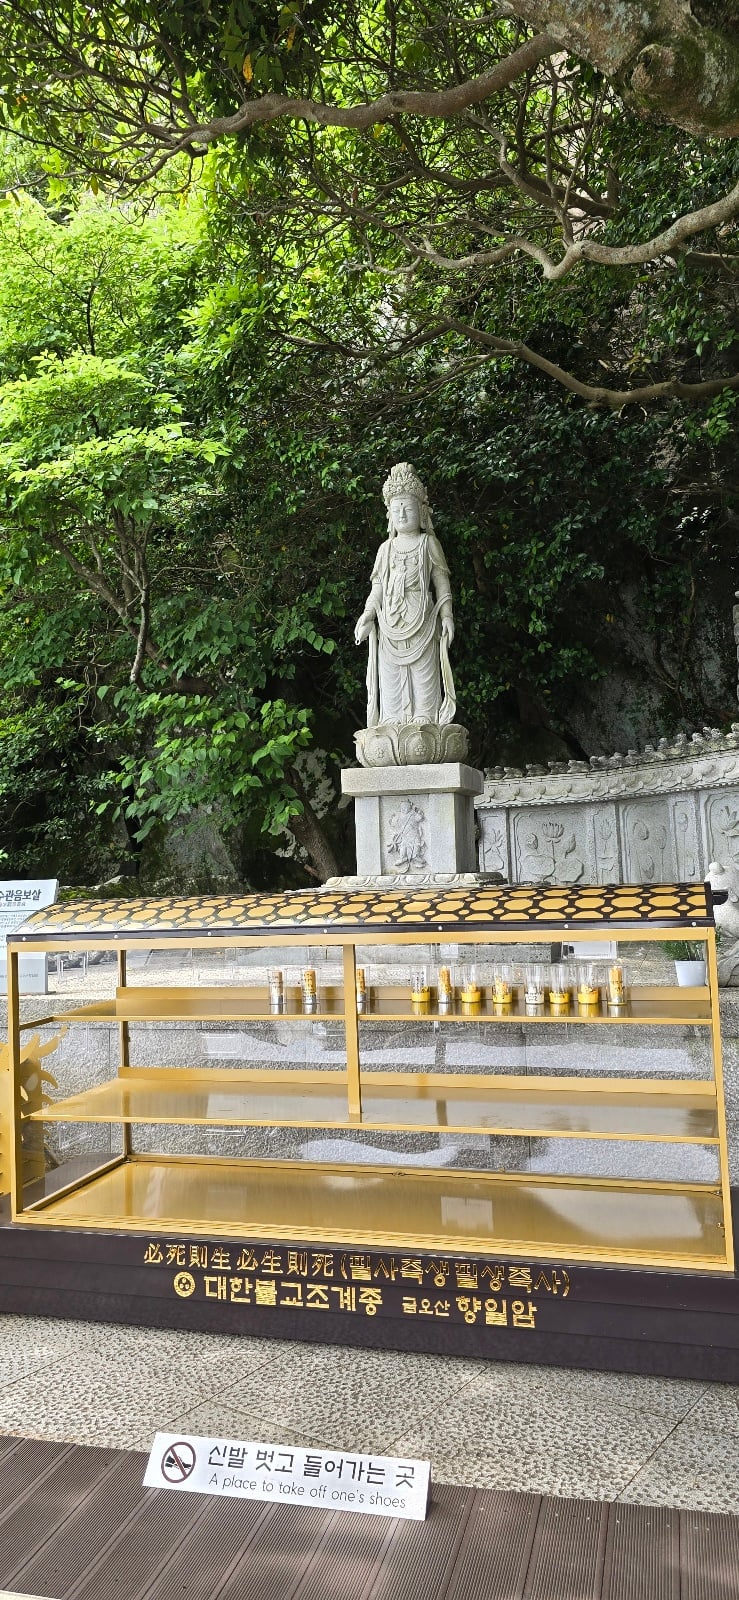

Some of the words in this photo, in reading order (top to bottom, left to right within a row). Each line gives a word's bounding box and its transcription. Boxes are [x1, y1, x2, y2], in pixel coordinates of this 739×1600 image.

[203, 1275, 383, 1316] 대한불교조계종
[455, 1295, 538, 1329] 향일암
[208, 1445, 248, 1469] 신발
[255, 1450, 295, 1473] 벗고
[303, 1454, 386, 1485] 들어가는
[395, 1465, 415, 1489] 곳
[208, 1473, 218, 1486] A
[222, 1475, 257, 1490] place
[262, 1480, 274, 1492] to
[279, 1481, 305, 1496] take
[309, 1485, 327, 1499] off
[331, 1489, 365, 1503] one's
[369, 1491, 406, 1509] shoes
